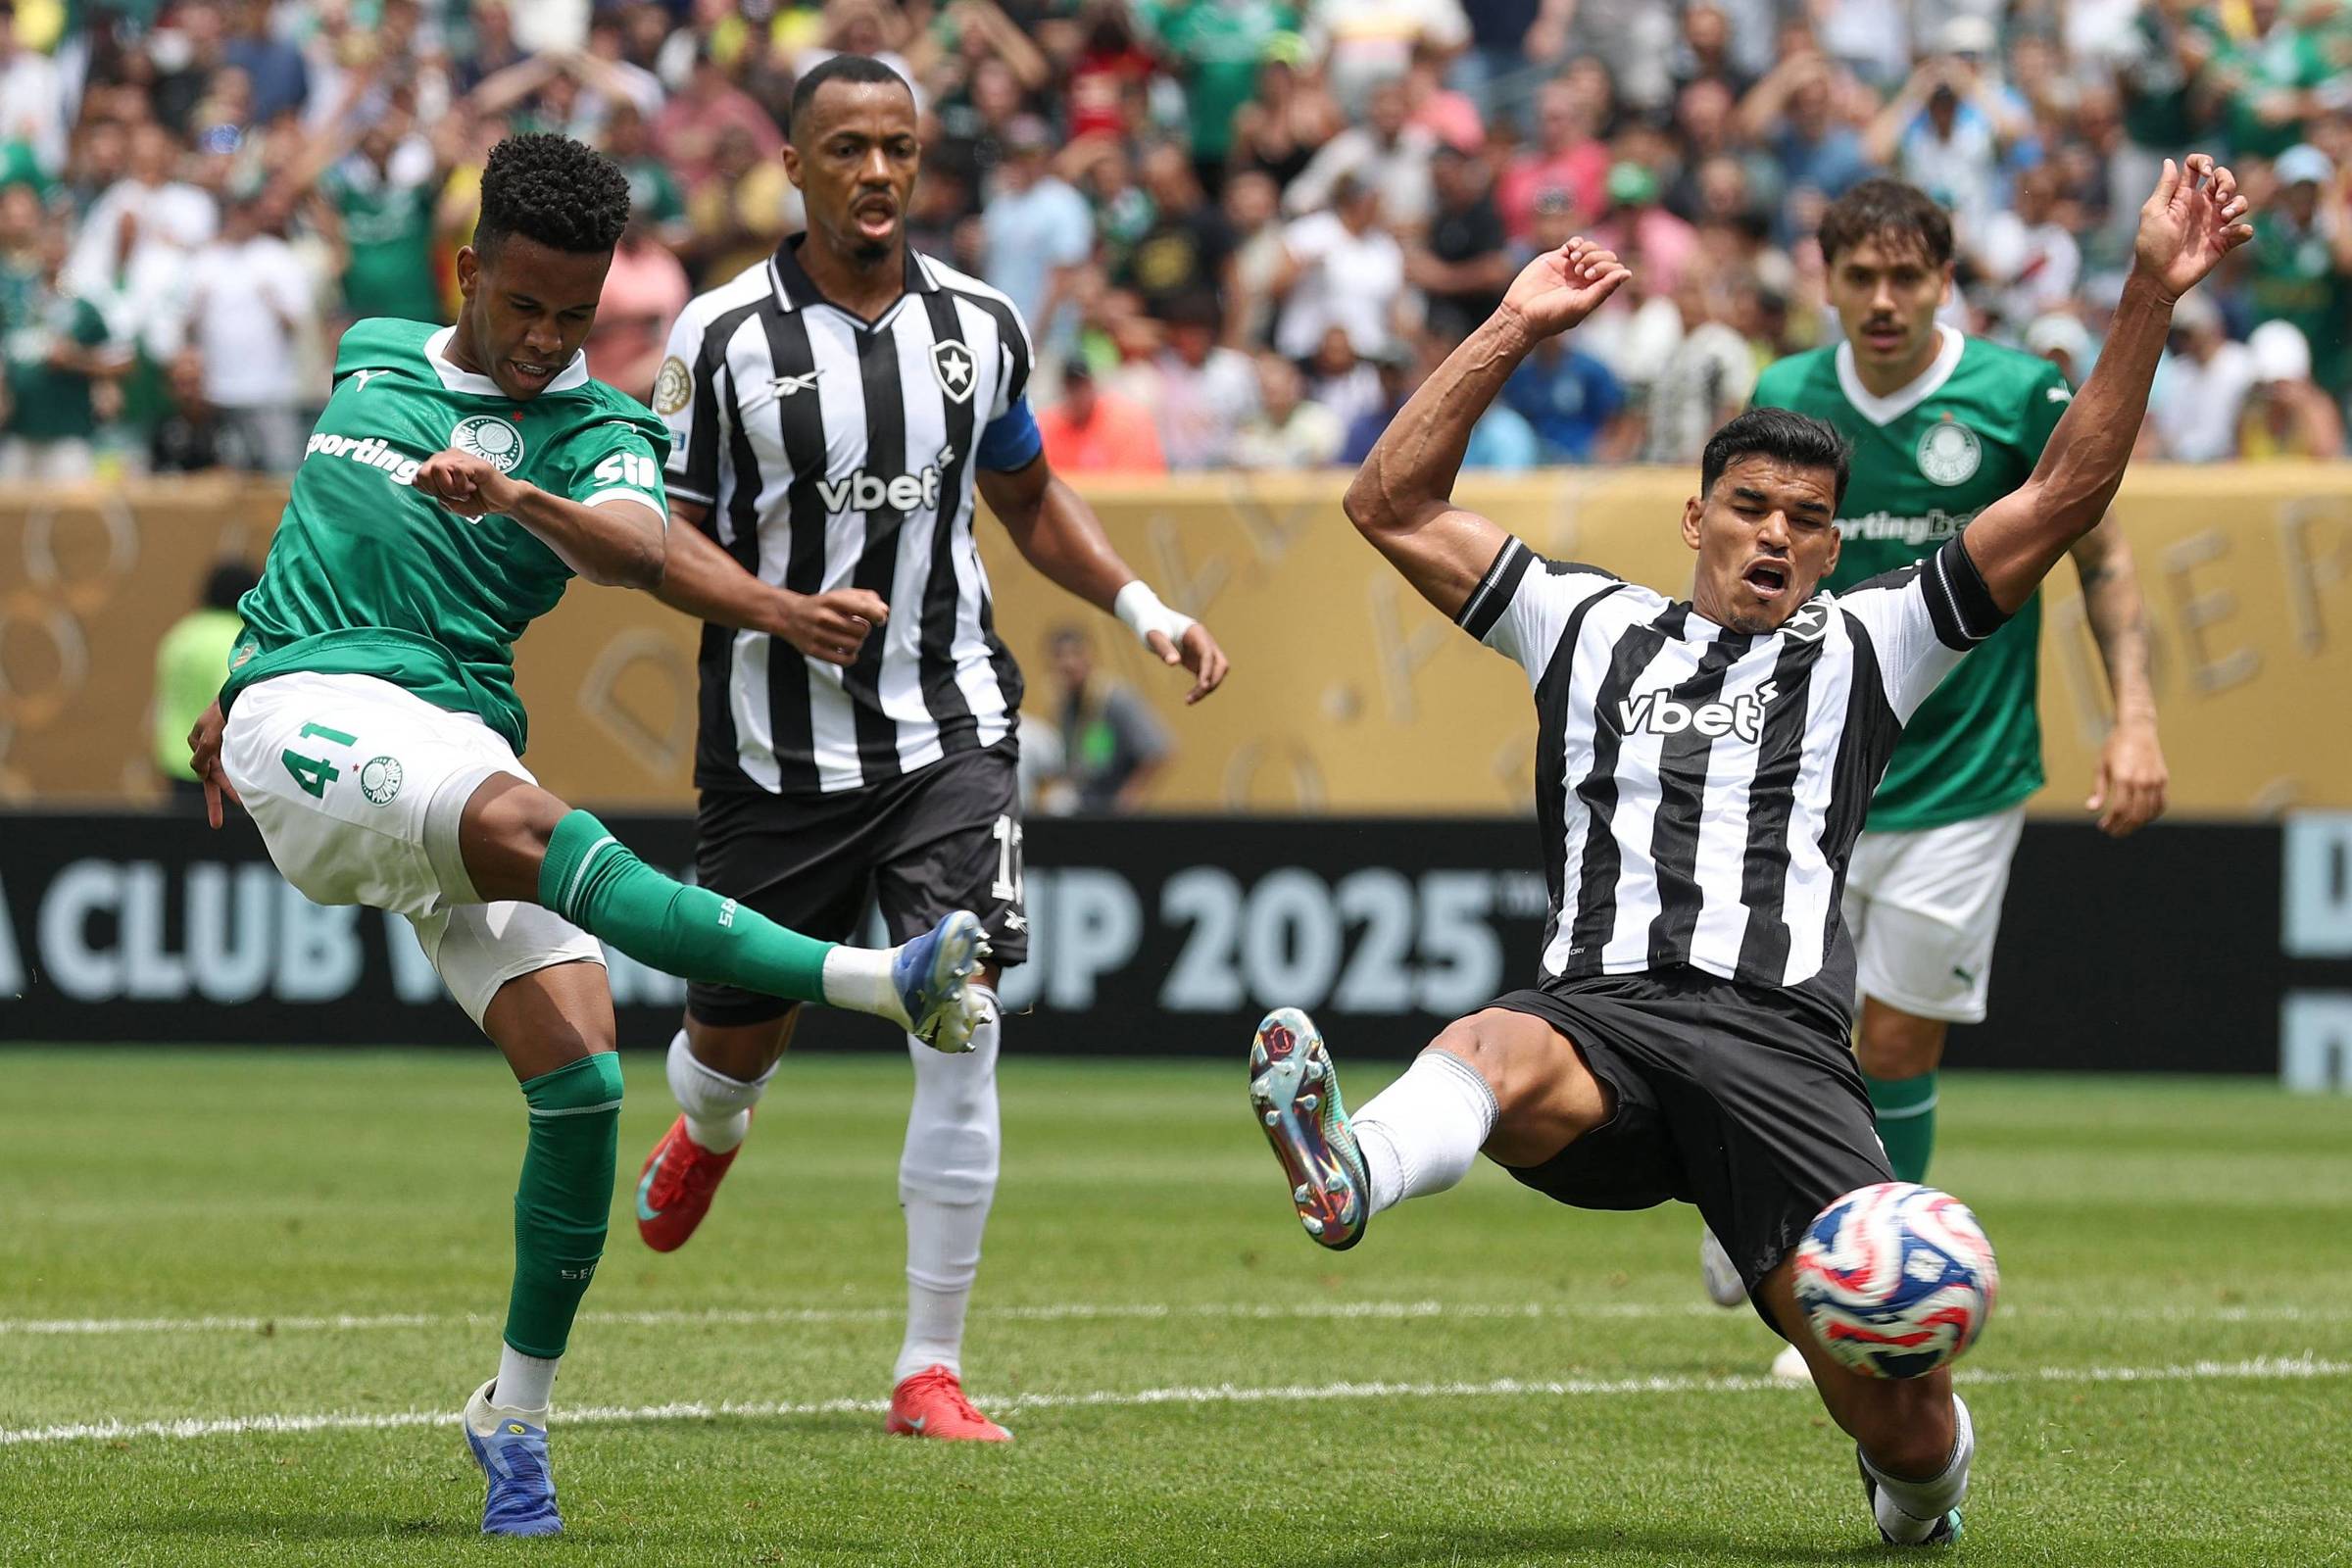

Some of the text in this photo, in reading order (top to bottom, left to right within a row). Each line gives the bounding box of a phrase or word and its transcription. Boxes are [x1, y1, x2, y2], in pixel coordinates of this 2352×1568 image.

[304, 432, 423, 486] porting
[815, 466, 942, 514] vbet
[1618, 688, 1760, 744] vbet
[281, 721, 359, 799] 41
[37, 858, 363, 1003] CLUB
[1156, 864, 1503, 1015] 2025
